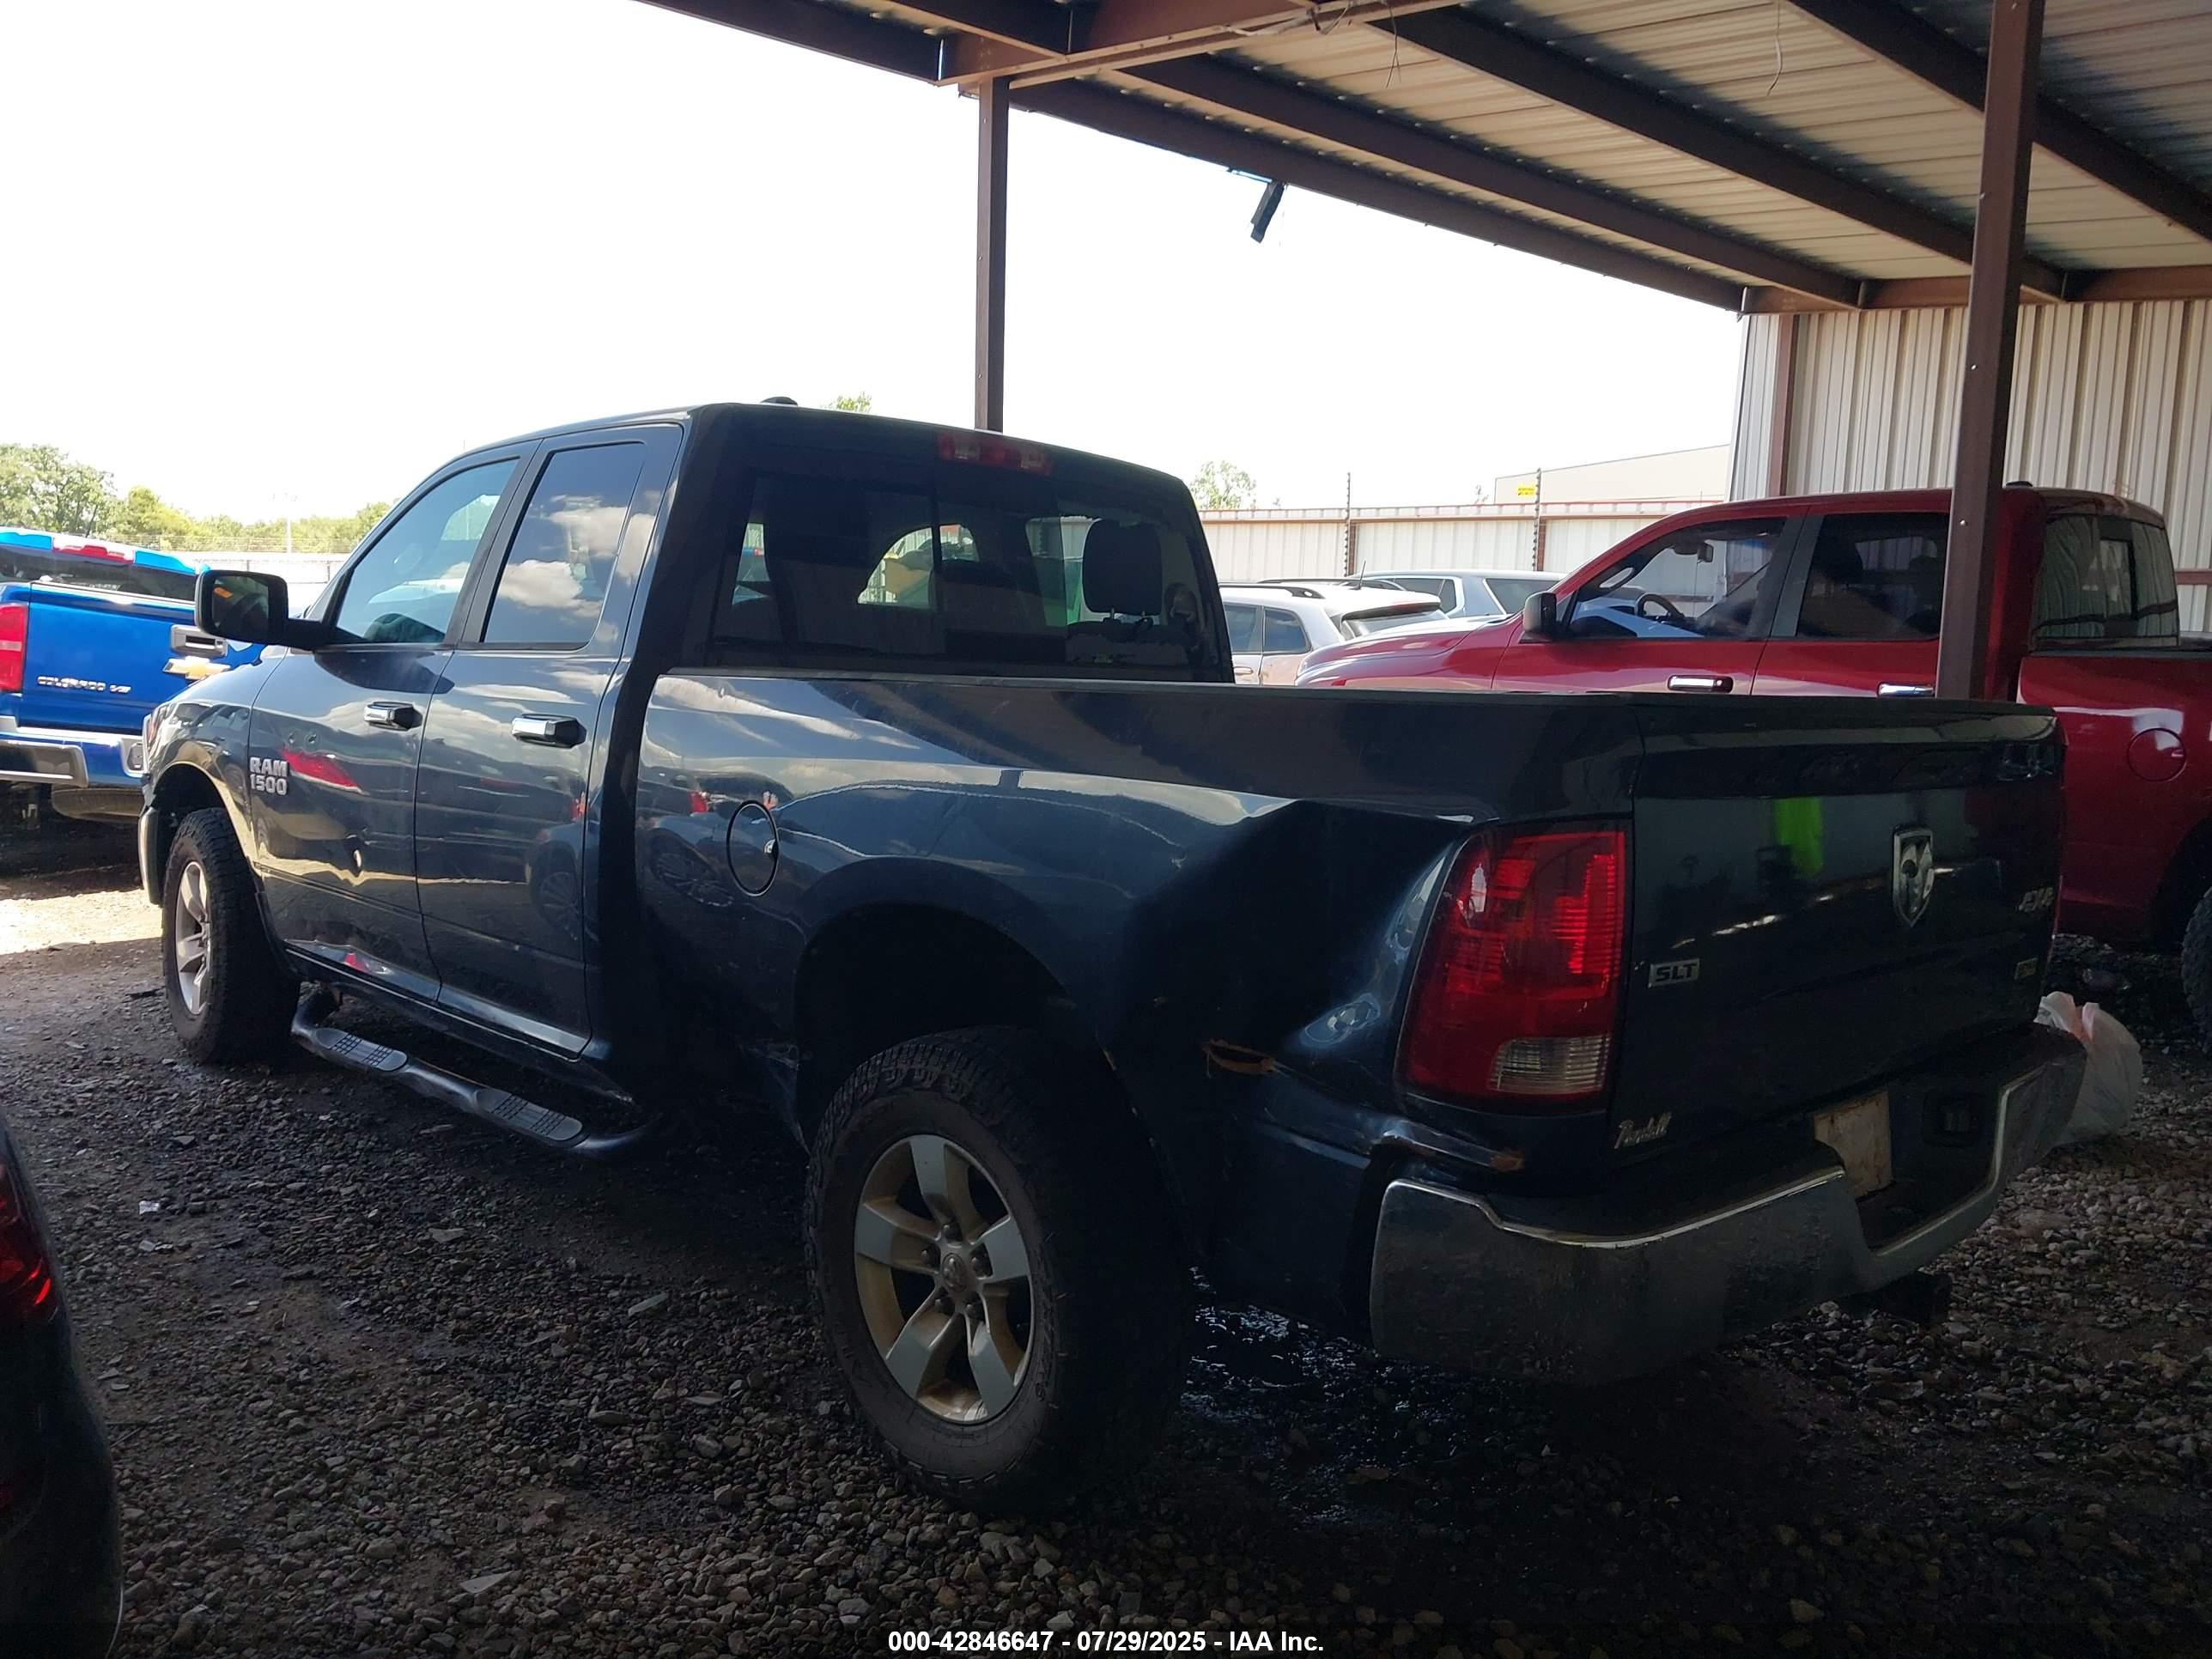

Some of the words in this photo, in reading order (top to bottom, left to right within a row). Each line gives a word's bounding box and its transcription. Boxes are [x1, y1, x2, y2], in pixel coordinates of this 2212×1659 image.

[249, 756, 289, 777] RAM
[249, 773, 288, 796] 1500
[1655, 963, 1698, 981] SLT
